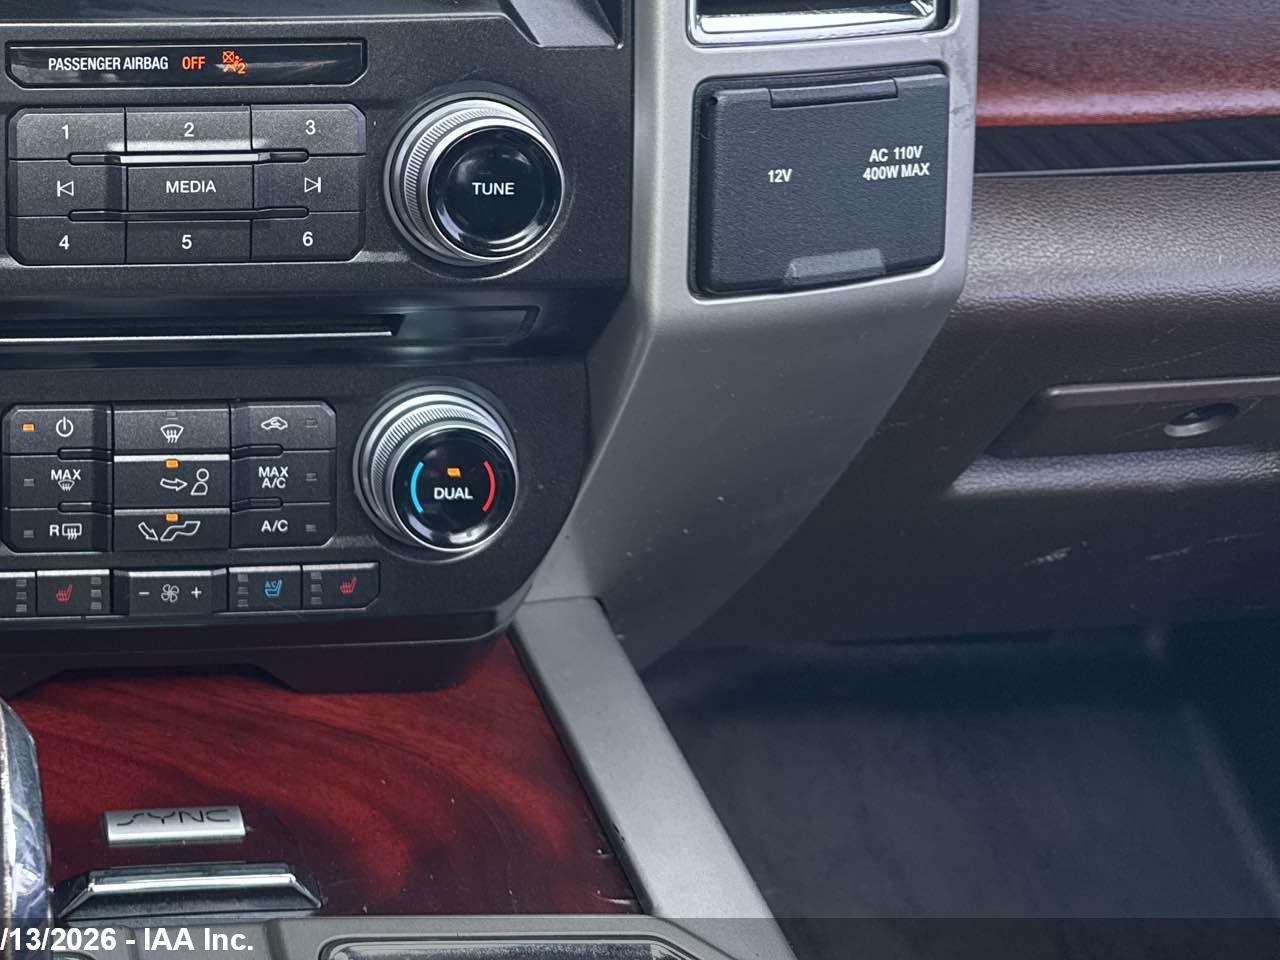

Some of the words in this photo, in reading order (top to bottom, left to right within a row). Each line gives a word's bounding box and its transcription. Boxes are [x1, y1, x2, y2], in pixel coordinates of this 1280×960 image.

[48, 56, 121, 71] PASSENGER
[123, 56, 168, 71] AIRBAG
[182, 56, 206, 70] OFF
[61, 125, 70, 139] 1
[183, 122, 195, 137] 2
[305, 120, 316, 135] 3
[869, 148, 889, 162] AC
[893, 145, 923, 160] 110V
[768, 169, 792, 183] 12V
[862, 165, 899, 181] 400W
[901, 163, 930, 178] MAX
[165, 180, 216, 194] MEDIA
[472, 182, 515, 196] TUNE
[58, 235, 70, 249] 4
[181, 234, 193, 249] 5
[302, 231, 314, 246] 6
[51, 469, 81, 481] MAX
[258, 466, 289, 477] MAX
[261, 477, 286, 489] A/C
[433, 487, 473, 500] DUAL
[49, 524, 60, 537] R
[261, 519, 288, 532] A/C
[116, 808, 231, 826] SYNC
